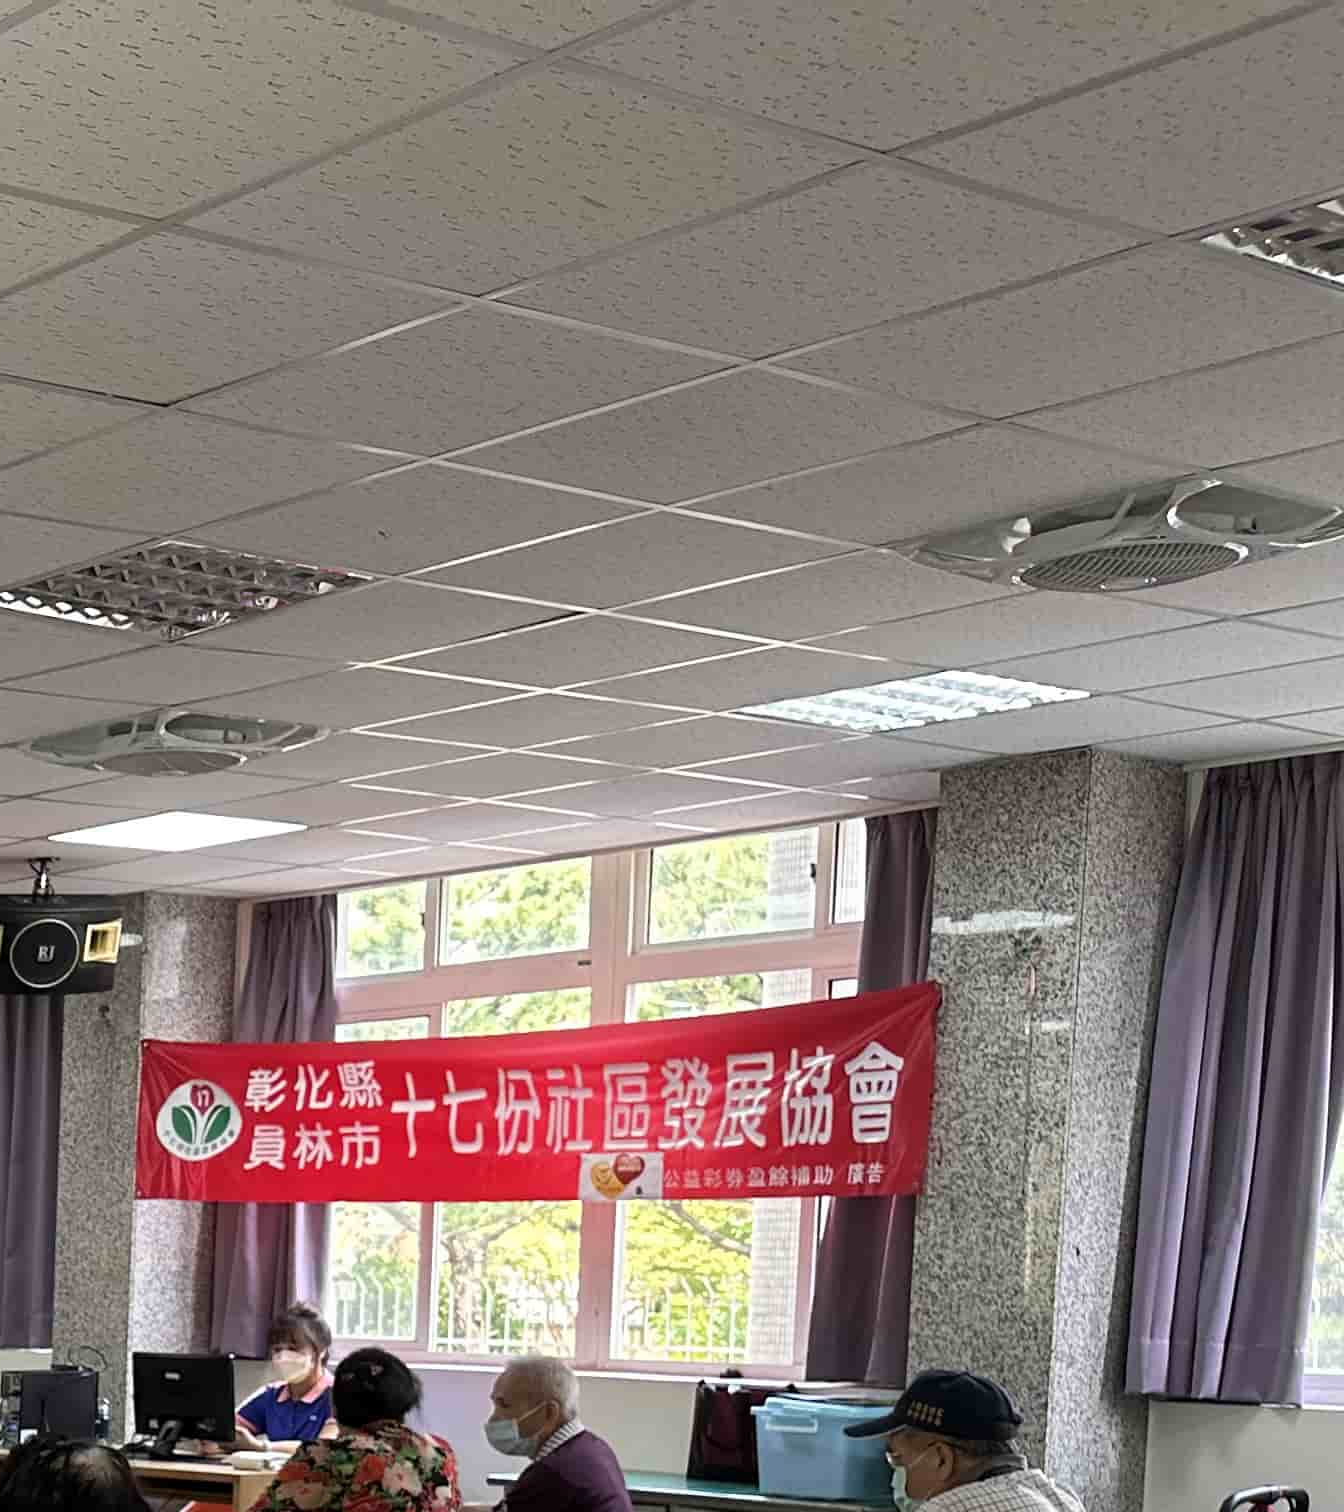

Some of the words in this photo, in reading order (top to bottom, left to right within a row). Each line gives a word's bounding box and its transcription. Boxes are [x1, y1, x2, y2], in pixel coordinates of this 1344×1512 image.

[243, 1060, 383, 1111] 彰化縣
[391, 1041, 905, 1158] 十七份社區發展協會
[243, 1121, 382, 1171] 員林市
[848, 1162, 885, 1185] 廣告
